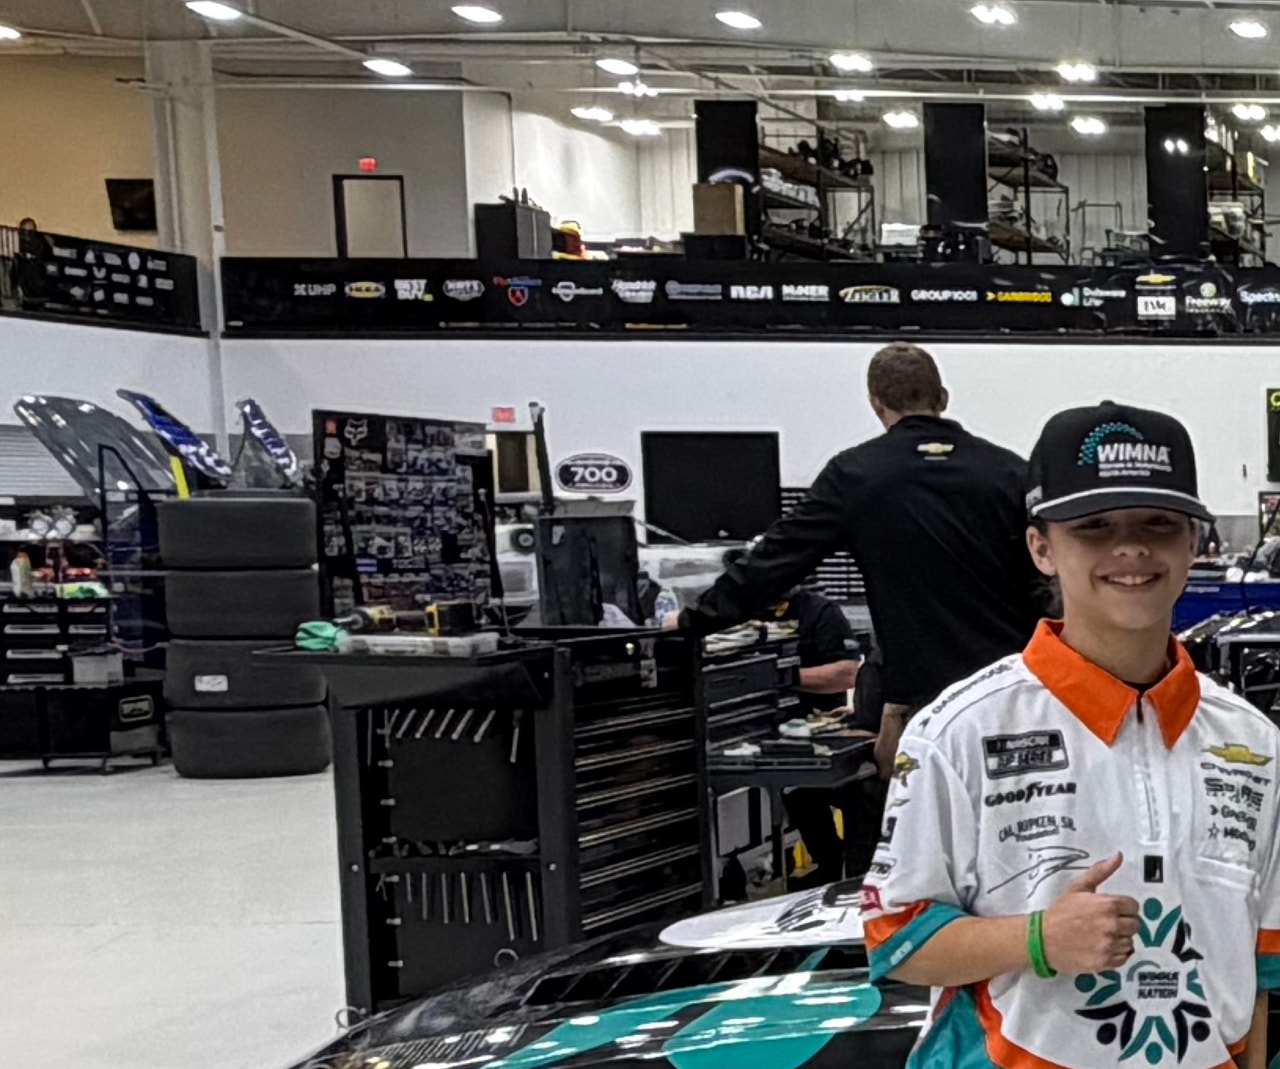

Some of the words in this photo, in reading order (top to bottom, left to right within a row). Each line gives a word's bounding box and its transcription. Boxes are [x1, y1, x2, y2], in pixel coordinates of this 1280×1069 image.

[1096, 442, 1170, 464] WIMNA
[570, 466, 618, 482] 700
[985, 781, 1077, 808] GOODYEAR
